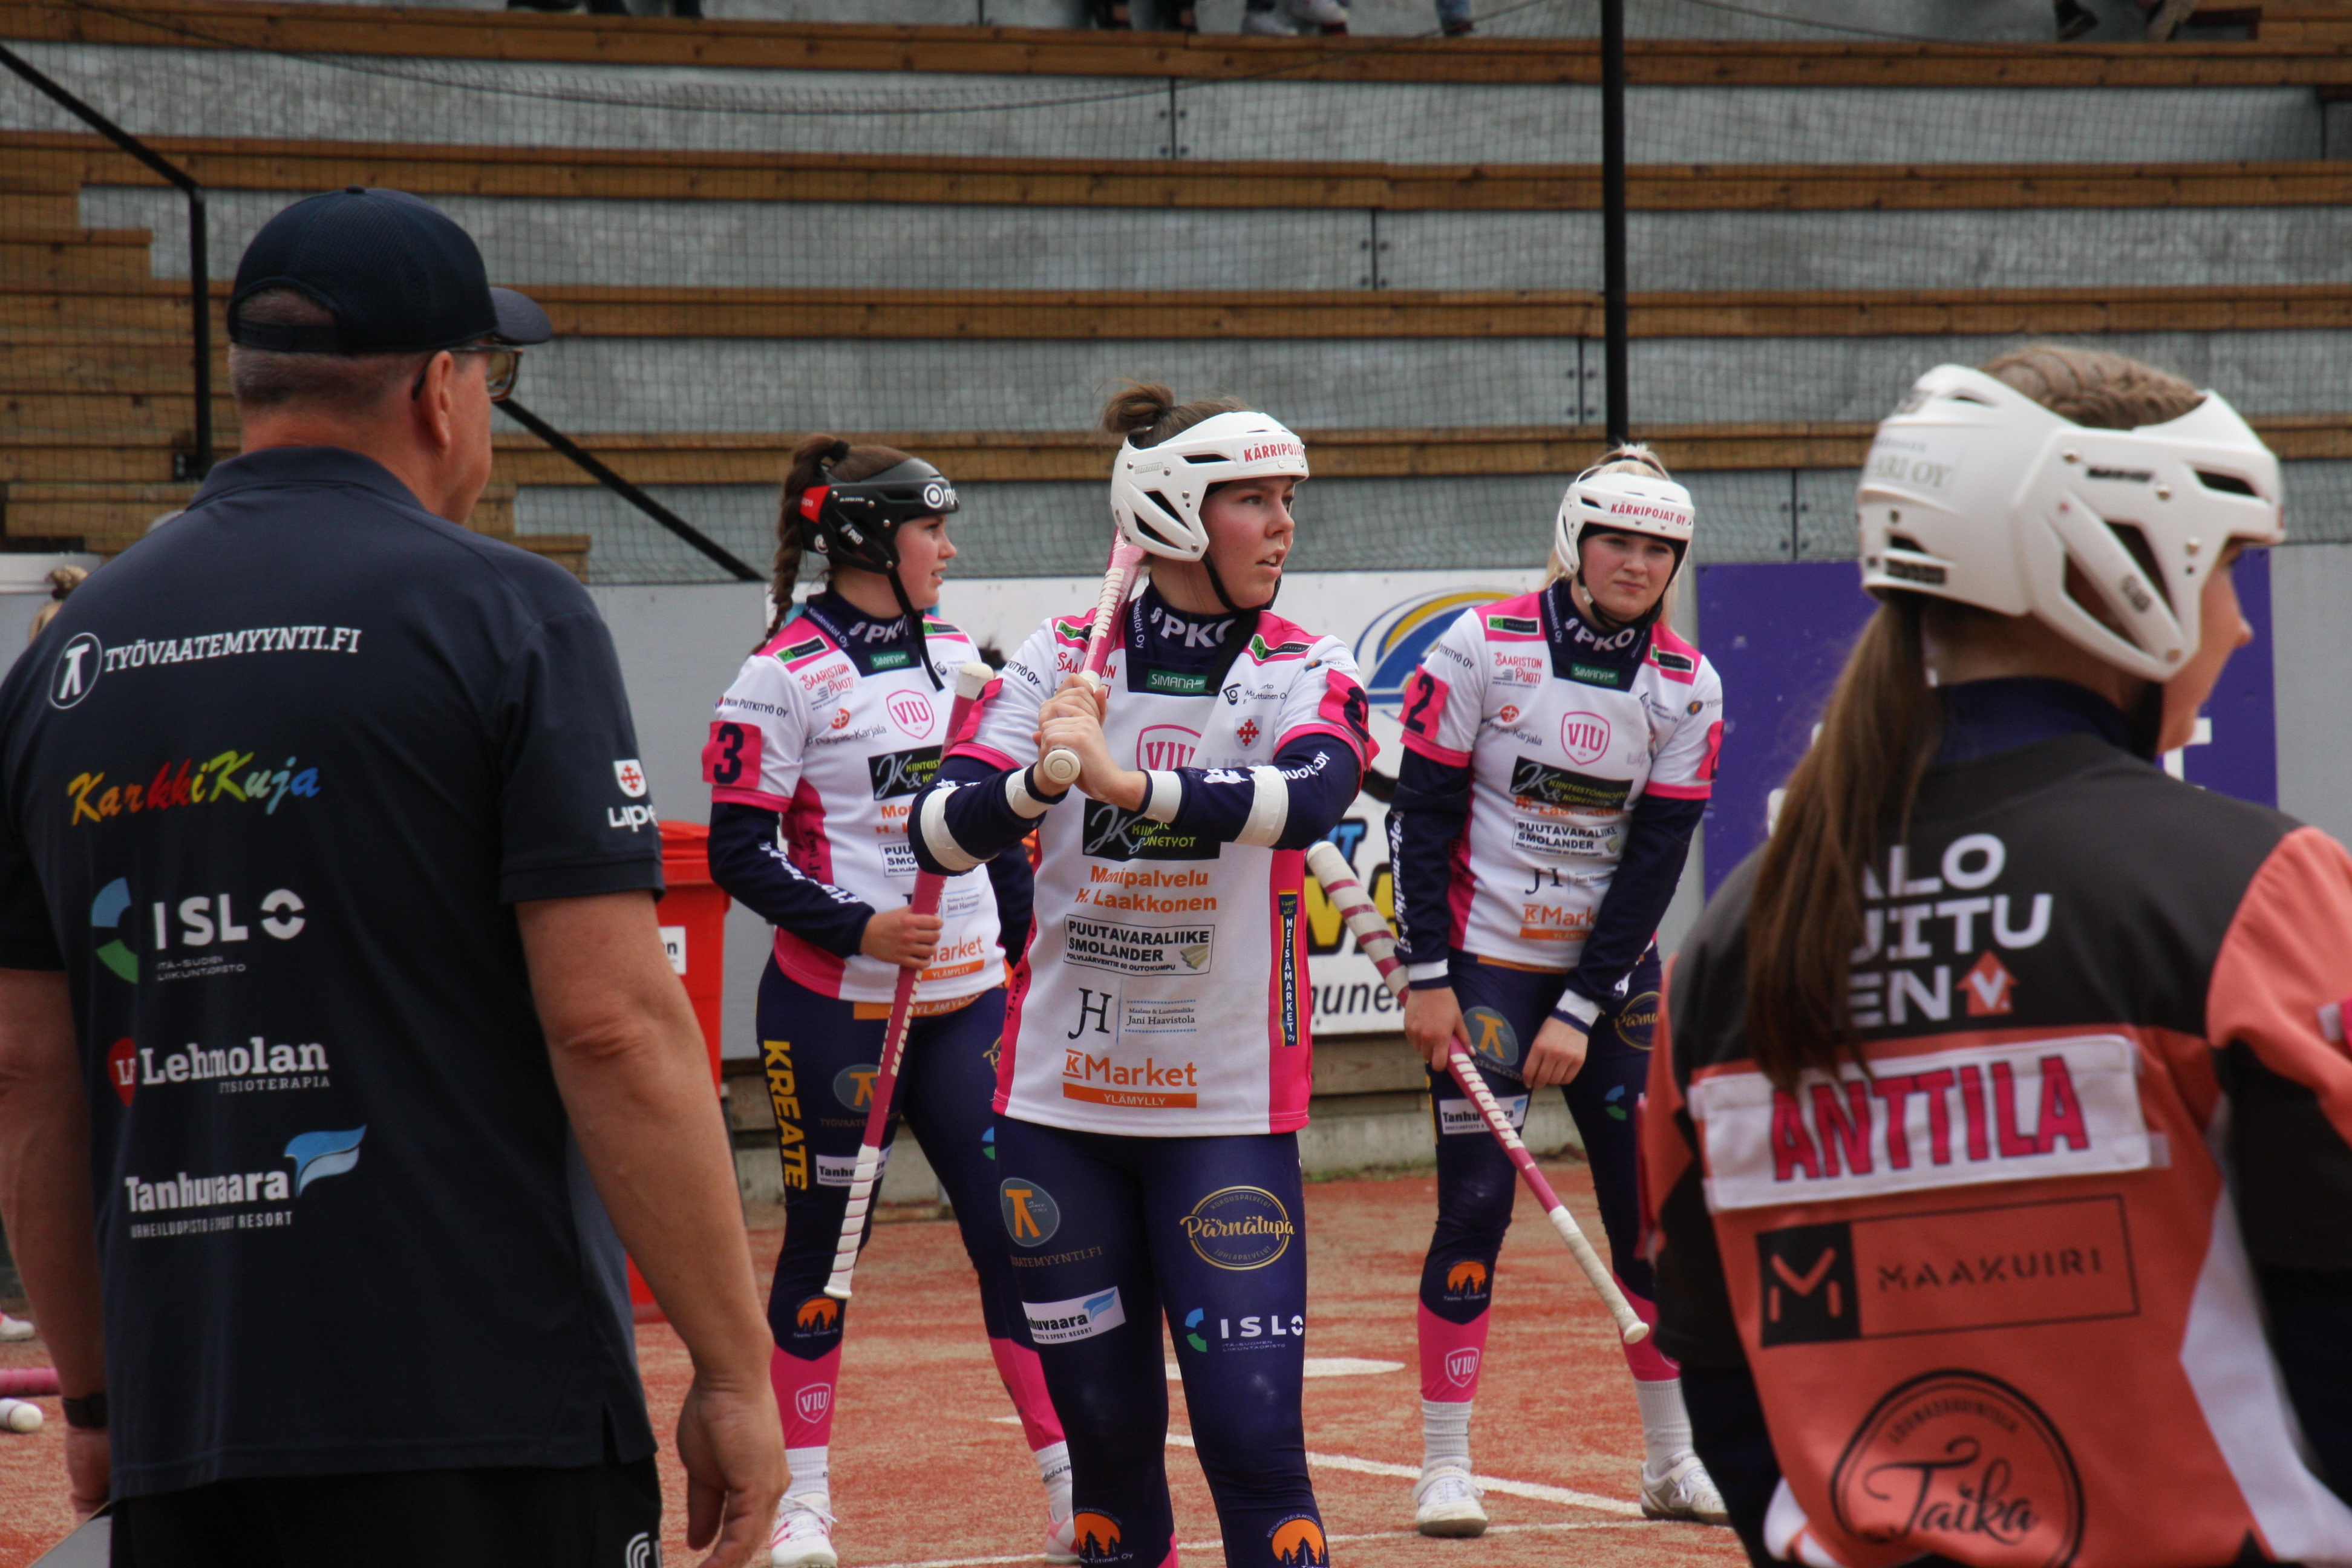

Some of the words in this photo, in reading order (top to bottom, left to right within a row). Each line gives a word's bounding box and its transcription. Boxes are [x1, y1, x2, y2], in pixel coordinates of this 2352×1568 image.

[1676, 514, 1687, 526] OY
[103, 626, 362, 673] TYÖVAATEMYYNTI.FI
[1135, 634, 1145, 648] Oy
[1574, 627, 1636, 652] PKO
[1463, 656, 1475, 670] OY
[1494, 652, 1543, 670] SAARISTON
[799, 662, 850, 691] SAARISTON
[1027, 671, 1041, 686] OY
[1515, 667, 1541, 685] PUOTI
[739, 698, 775, 714] PUTKITYÖ
[776, 706, 789, 718] OY
[892, 701, 929, 725] VIU
[1405, 674, 1435, 735] 2
[1567, 724, 1605, 752] VIU
[713, 722, 745, 785] 3
[67, 750, 321, 826] KarkkiKuja
[907, 771, 922, 789] &
[1518, 821, 1618, 838] PUUTAVARALIIKE
[1518, 832, 1595, 850] SMOLANDER
[1089, 864, 1209, 889] Monipalvelu
[1074, 887, 1090, 903] H.
[1093, 889, 1218, 913] Laakkonen
[154, 888, 306, 950] ISLO
[1068, 920, 1210, 945] PUUTAVARALIIKE
[1068, 936, 1164, 962] SMOLANDER
[932, 965, 972, 978] YLÄMYLLY
[1067, 952, 1119, 968] POLVIJÄRVENTIE
[1129, 964, 1176, 972] OUTOKUMPU
[1284, 918, 1293, 1032] METSÄMARKET
[1068, 987, 1112, 1040] JH
[1126, 1015, 1145, 1026] Jani
[1148, 1015, 1195, 1025] Haavistola
[1287, 1034, 1296, 1042] Oy
[140, 1036, 329, 1085] Lehmolan
[1085, 1054, 1198, 1087] Market
[219, 1076, 331, 1094] FYSIOTERAPIA
[1104, 1093, 1166, 1106] YLÄMYLLY
[763, 1039, 808, 1192] KREATE
[1772, 1054, 2090, 1183] ANTTILA
[125, 1170, 289, 1213] Tanhuvaara
[1210, 1194, 1272, 1210] KOKOUSPALVELUT
[238, 1210, 293, 1229] RESORT
[1180, 1215, 1295, 1241] Pärnätupa
[1214, 1245, 1272, 1261] JUHLAPALVELUT
[1878, 1247, 2103, 1293] MAAKUIRI
[1050, 1332, 1067, 1341] SPORT
[1068, 1327, 1093, 1338] RESORT
[1220, 1315, 1304, 1339] ISLO
[1451, 1356, 1477, 1377] VIU
[800, 1391, 828, 1413] VIU
[1861, 1436, 2041, 1546] Taika
